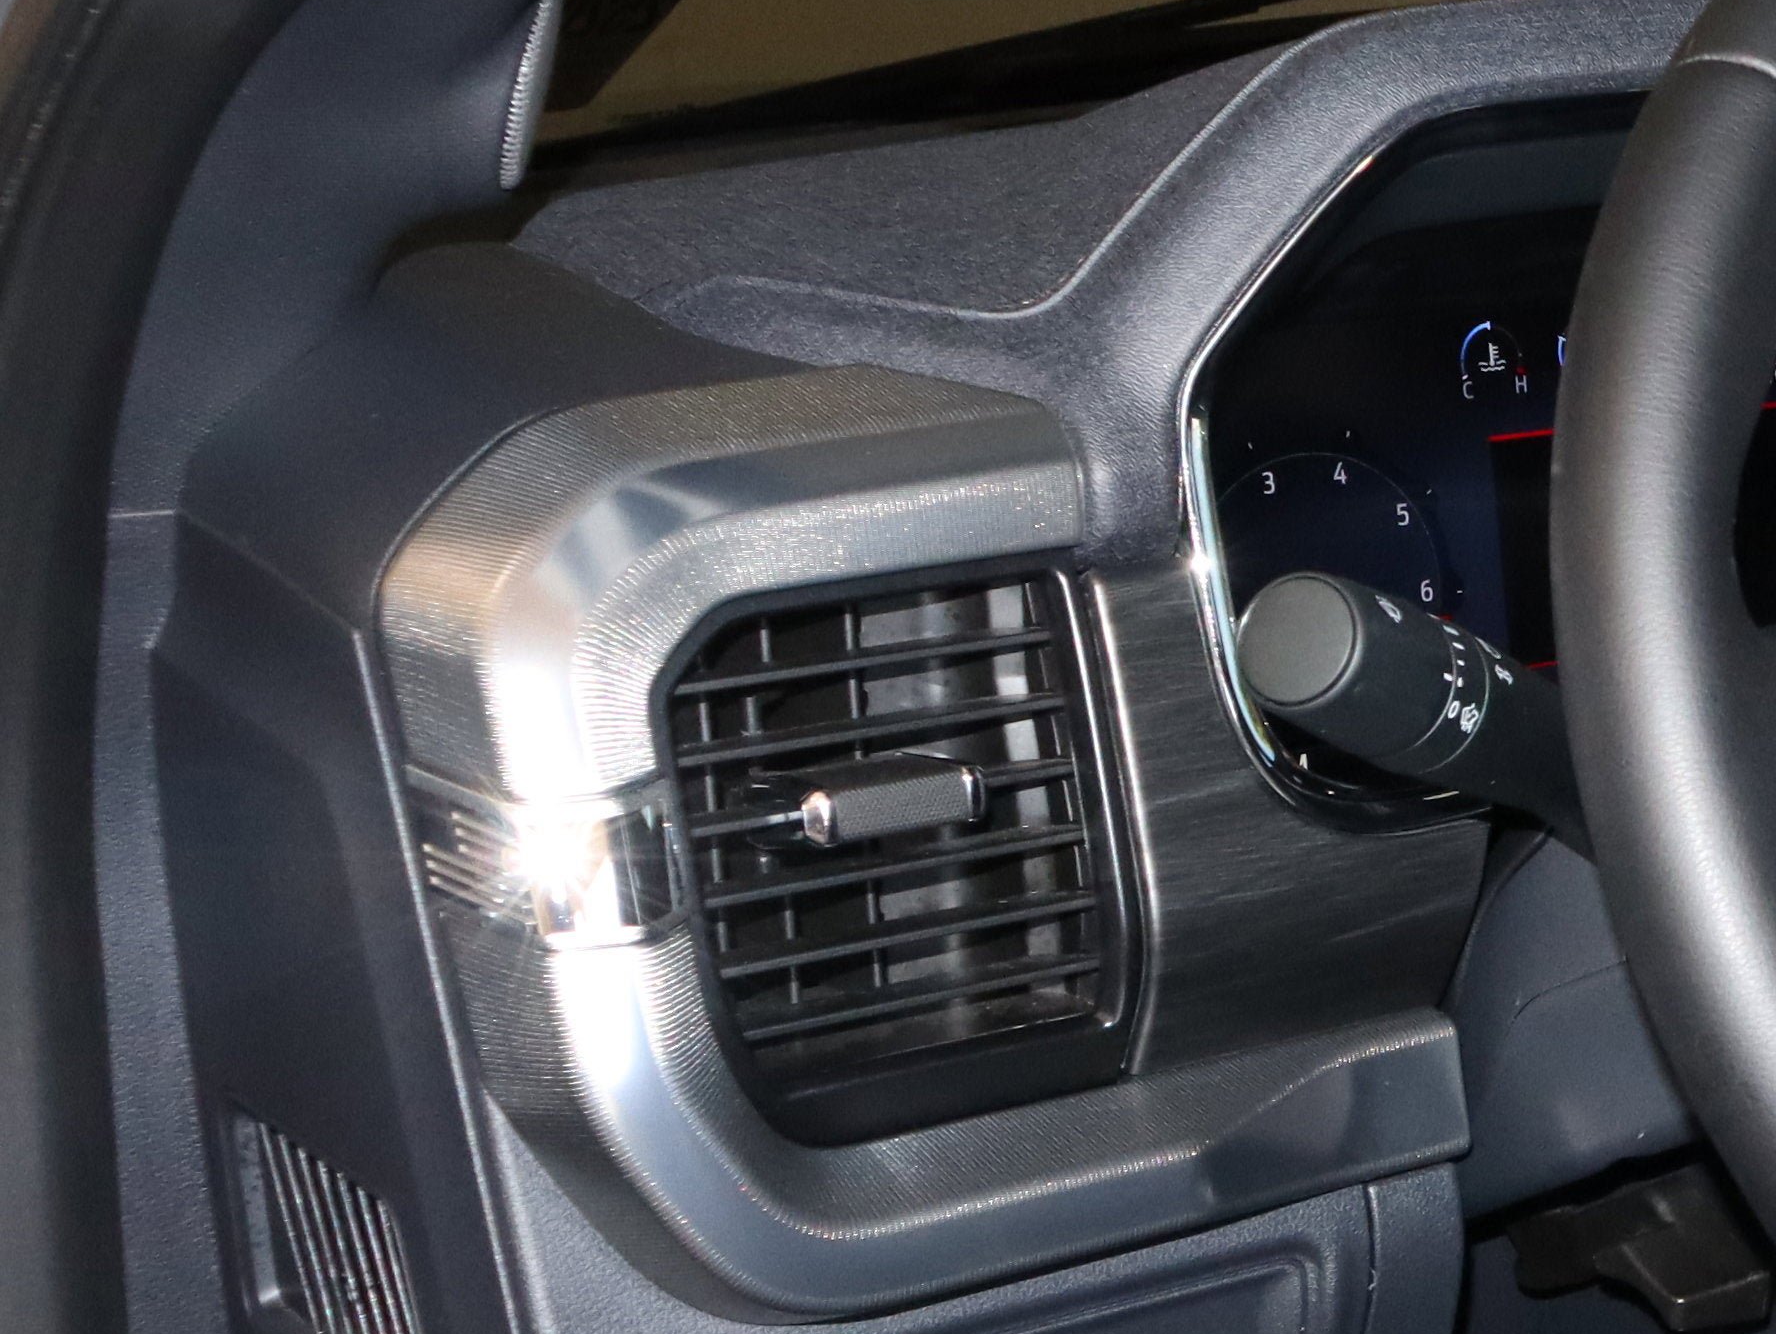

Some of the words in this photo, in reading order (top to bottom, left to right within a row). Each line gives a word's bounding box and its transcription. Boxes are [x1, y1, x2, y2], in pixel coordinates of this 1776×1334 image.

[1462, 381, 1474, 399] C
[1515, 375, 1527, 394] H
[1261, 471, 1276, 495] 3
[1333, 462, 1347, 484] 4
[1396, 503, 1409, 526] 5
[1420, 579, 1434, 602] 6
